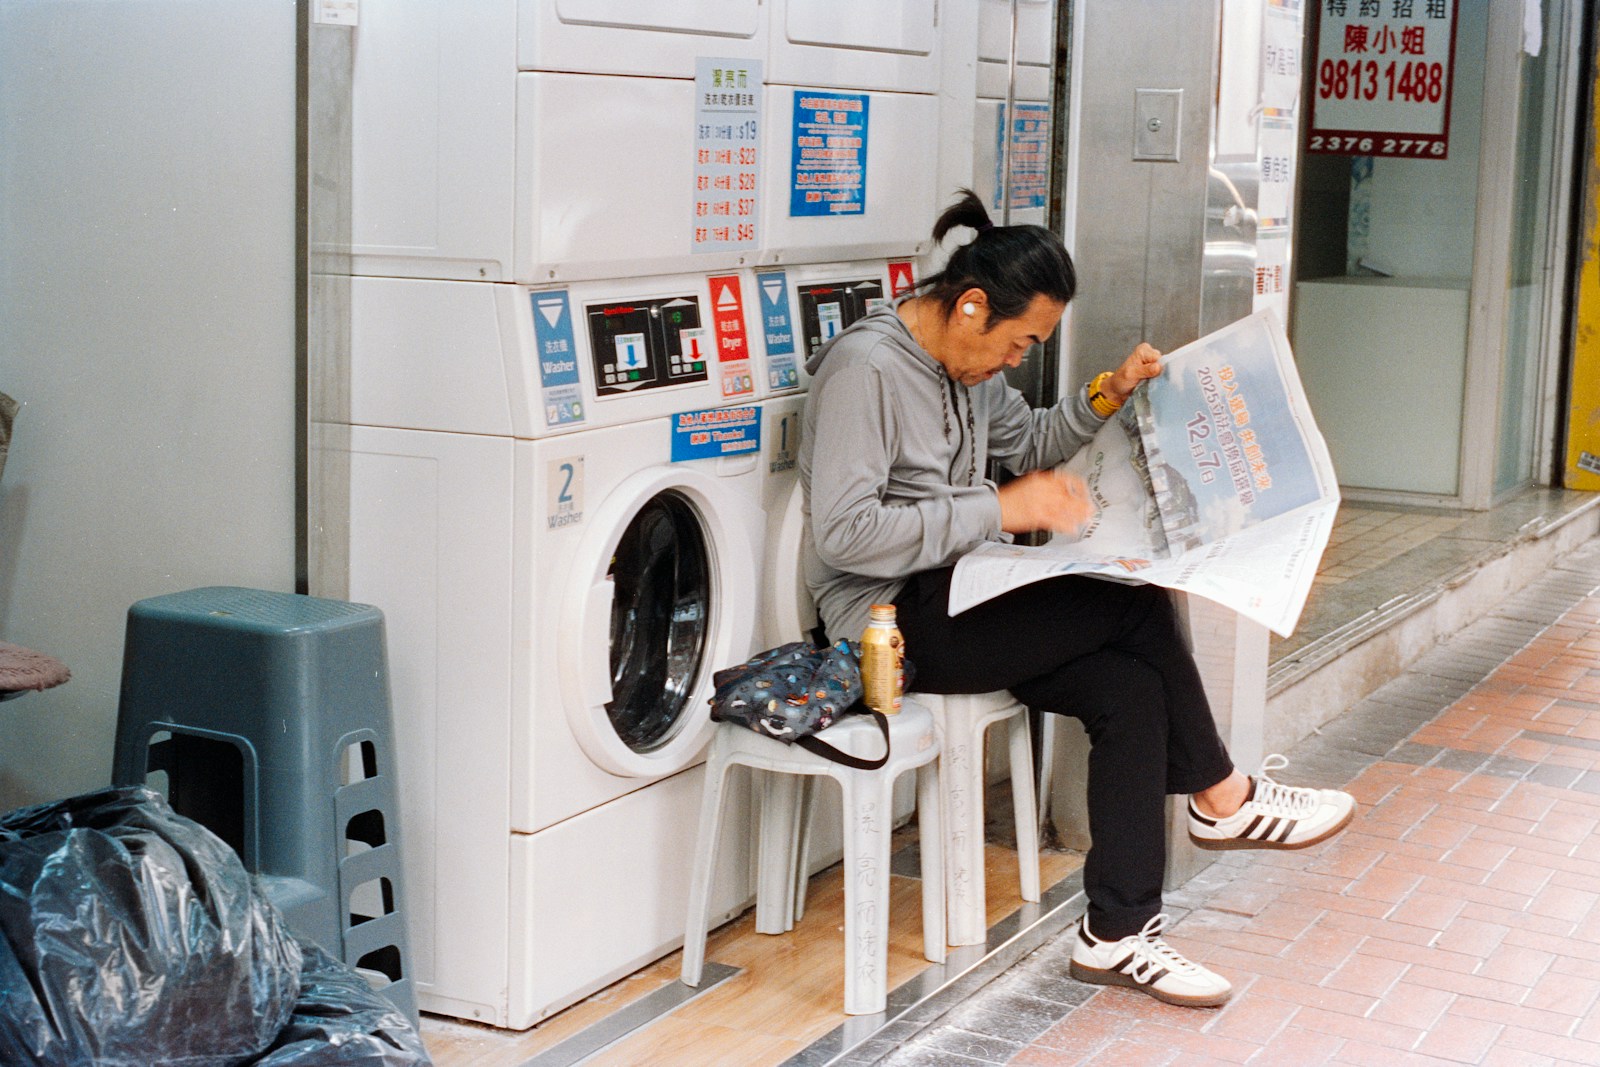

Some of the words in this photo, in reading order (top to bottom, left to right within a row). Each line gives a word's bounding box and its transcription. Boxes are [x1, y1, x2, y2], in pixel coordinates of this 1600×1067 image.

[1327, 0, 1446, 19] 特約招租
[1344, 24, 1425, 55] 陳小姐
[1310, 136, 1373, 152] 2376
[739, 147, 755, 165] $23
[739, 173, 755, 190] $28
[738, 198, 754, 216] $37
[738, 223, 753, 241] $45
[722, 337, 742, 350] Dryer
[766, 333, 790, 344] Washer
[542, 361, 574, 374] Washer
[712, 428, 745, 442] Thanks!
[781, 417, 787, 450] 1
[1186, 411, 1221, 485] 12月7日
[558, 463, 574, 503] 2
[547, 512, 583, 528] Washer
